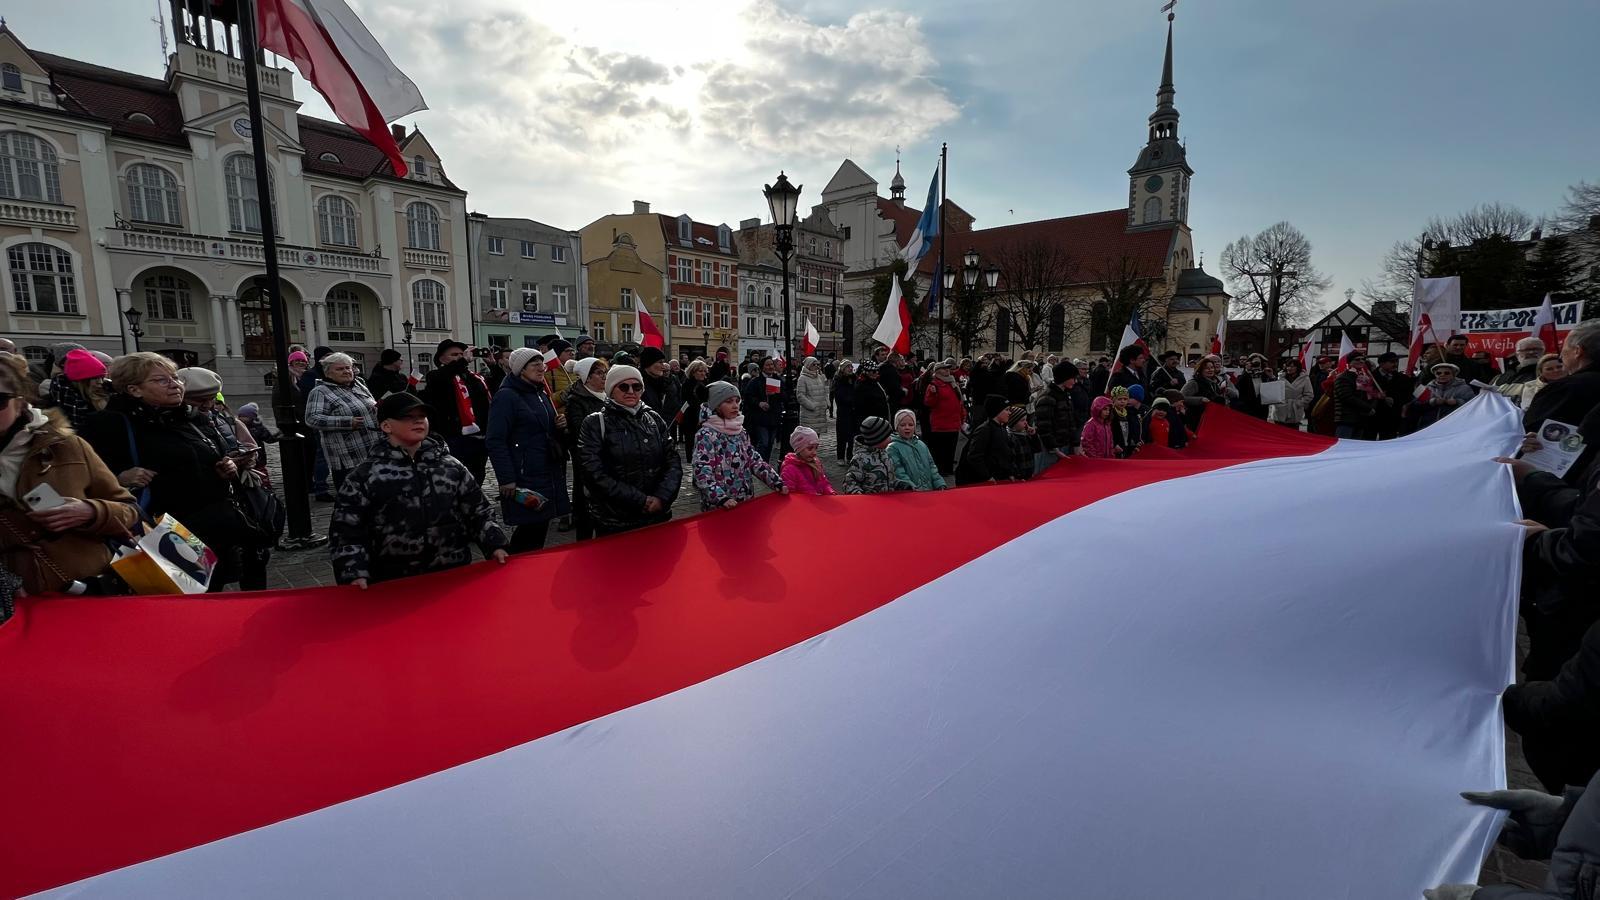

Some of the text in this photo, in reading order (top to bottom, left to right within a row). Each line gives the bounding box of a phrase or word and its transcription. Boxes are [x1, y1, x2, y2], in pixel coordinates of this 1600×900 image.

[1460, 304, 1577, 329] ETA POLKA
[1481, 337, 1516, 352] Wejh
